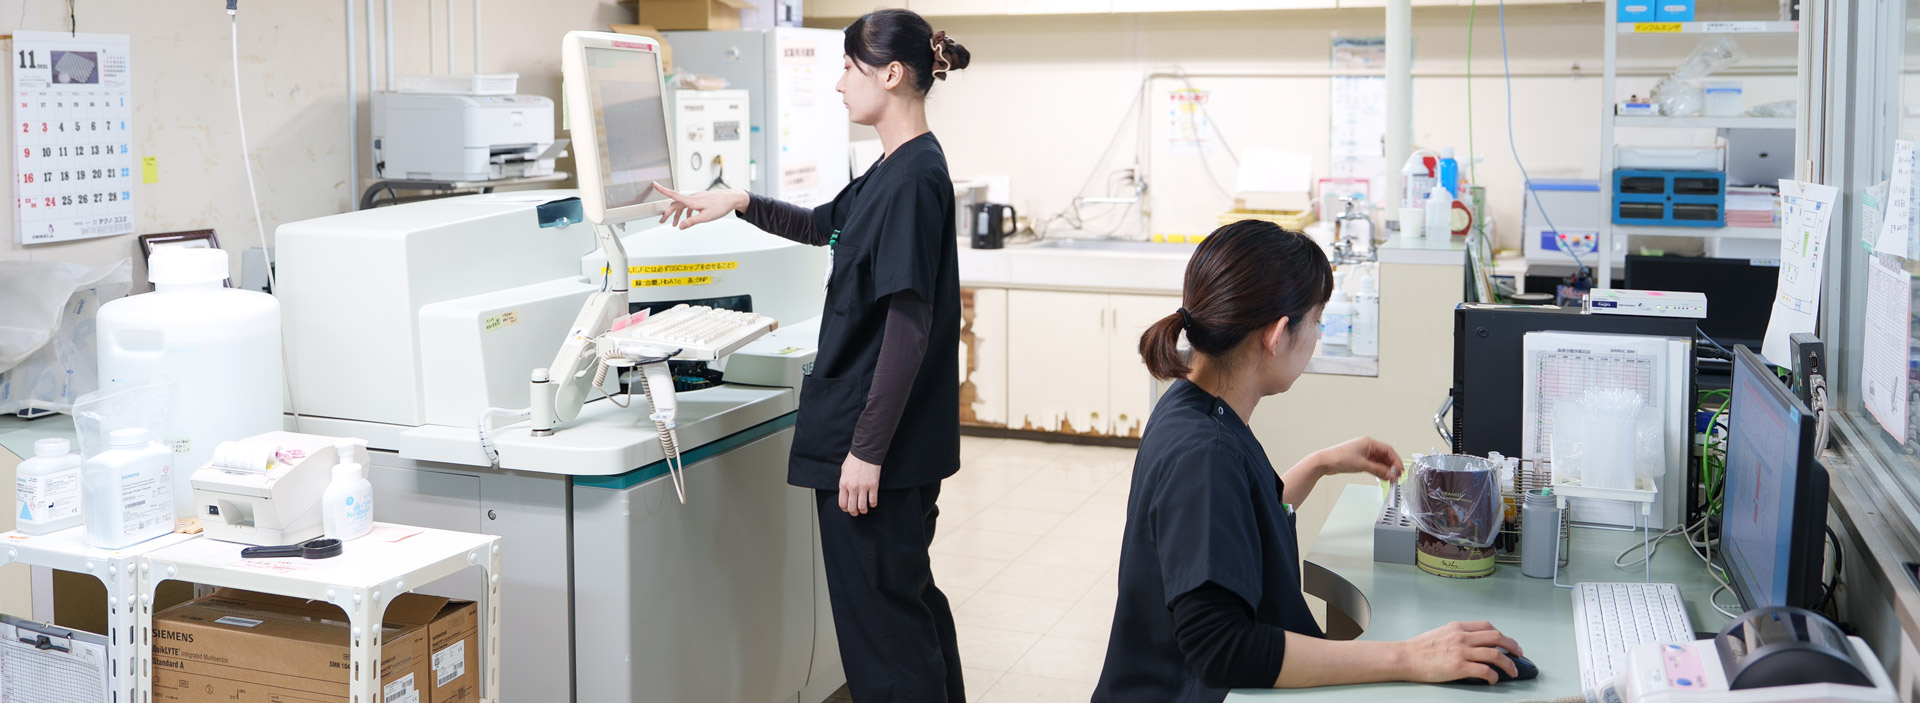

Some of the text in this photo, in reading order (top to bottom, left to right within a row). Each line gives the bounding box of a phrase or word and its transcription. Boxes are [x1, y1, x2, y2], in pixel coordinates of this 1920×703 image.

[19, 50, 36, 69] 11
[120, 97, 124, 107] 1
[23, 120, 125, 133] 2 3 4 5 6 7 8
[24, 144, 128, 158] 9 10 11 12 13 14 15
[24, 167, 129, 184] 16 17 18 19 20 21 22
[45, 197, 56, 207] 24
[62, 195, 73, 206] 25
[78, 194, 88, 204] 26
[94, 193, 103, 203] 27
[108, 192, 117, 202] 28
[122, 191, 130, 201] 29
[152, 628, 194, 643] SIEMENS
[152, 657, 185, 669] Standard A
